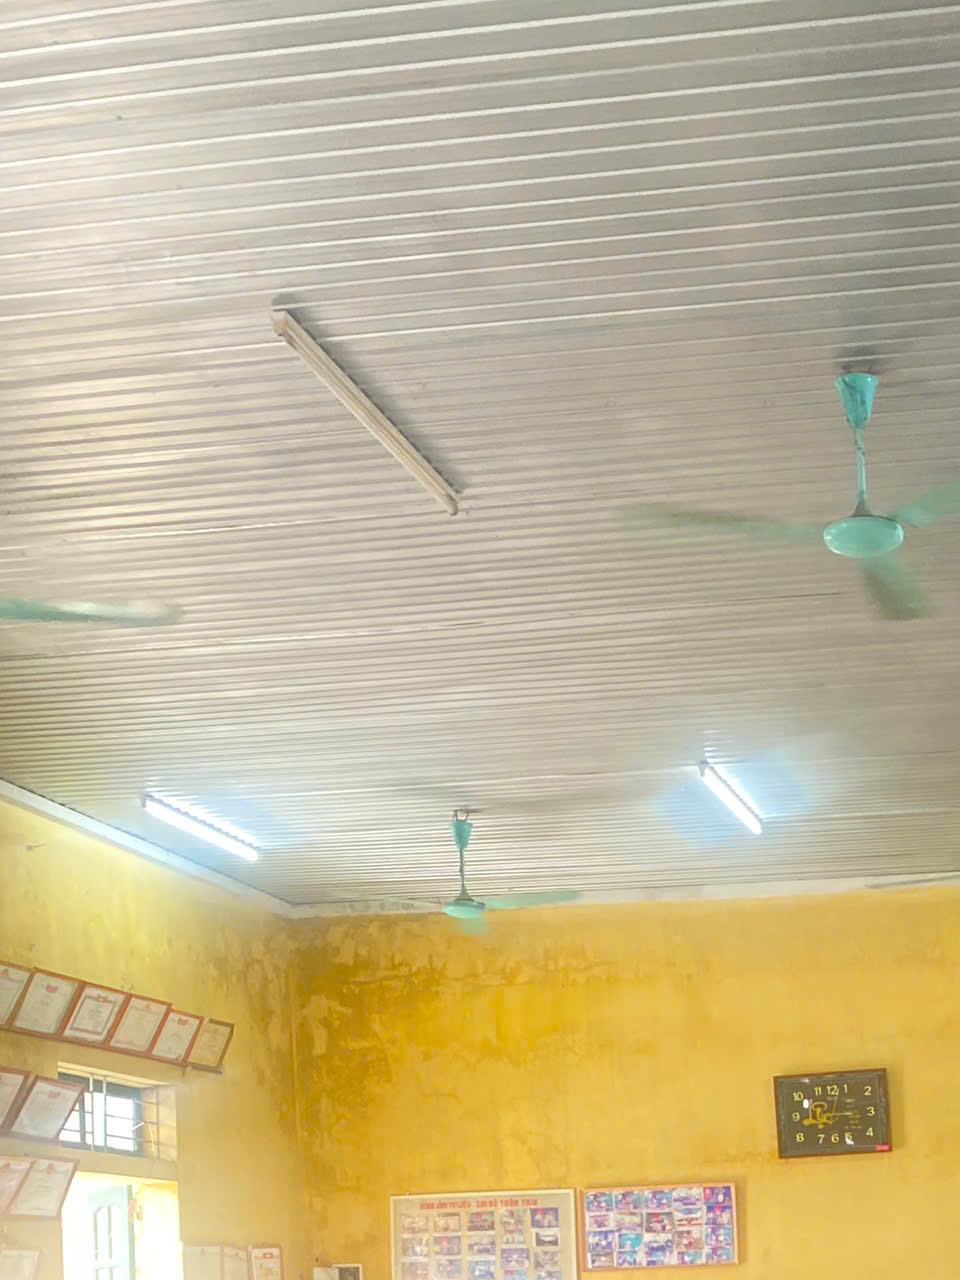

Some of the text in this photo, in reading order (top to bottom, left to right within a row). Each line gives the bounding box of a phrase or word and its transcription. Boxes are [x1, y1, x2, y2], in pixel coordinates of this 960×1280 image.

[815, 1086, 822, 1096] 11
[827, 1085, 837, 1095] 12
[864, 1086, 872, 1096] 2
[793, 1092, 803, 1101] 10
[867, 1107, 875, 1116] 3
[792, 1112, 800, 1121] 9
[866, 1128, 873, 1137] 4
[796, 1133, 805, 1142] 8
[818, 1134, 824, 1144] 7
[831, 1133, 839, 1143] 6
